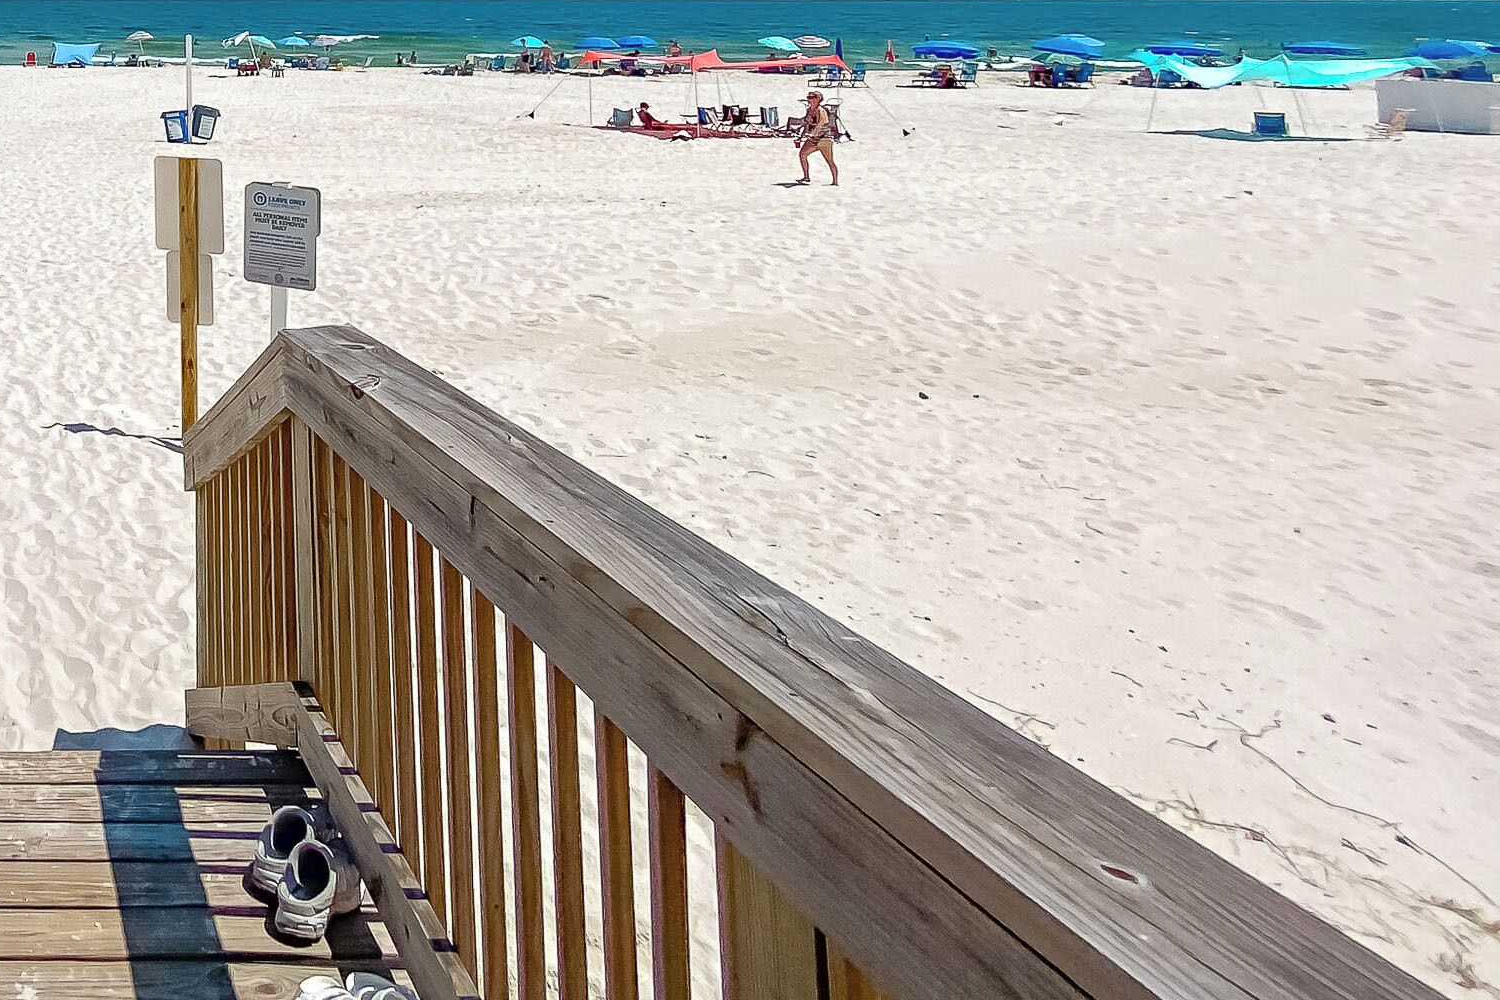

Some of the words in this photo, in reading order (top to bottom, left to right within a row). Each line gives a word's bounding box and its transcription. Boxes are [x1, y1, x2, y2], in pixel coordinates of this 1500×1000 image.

[263, 212, 291, 221] PERSONAL
[291, 216, 308, 224] ITEMS
[279, 220, 306, 228] REMOVED
